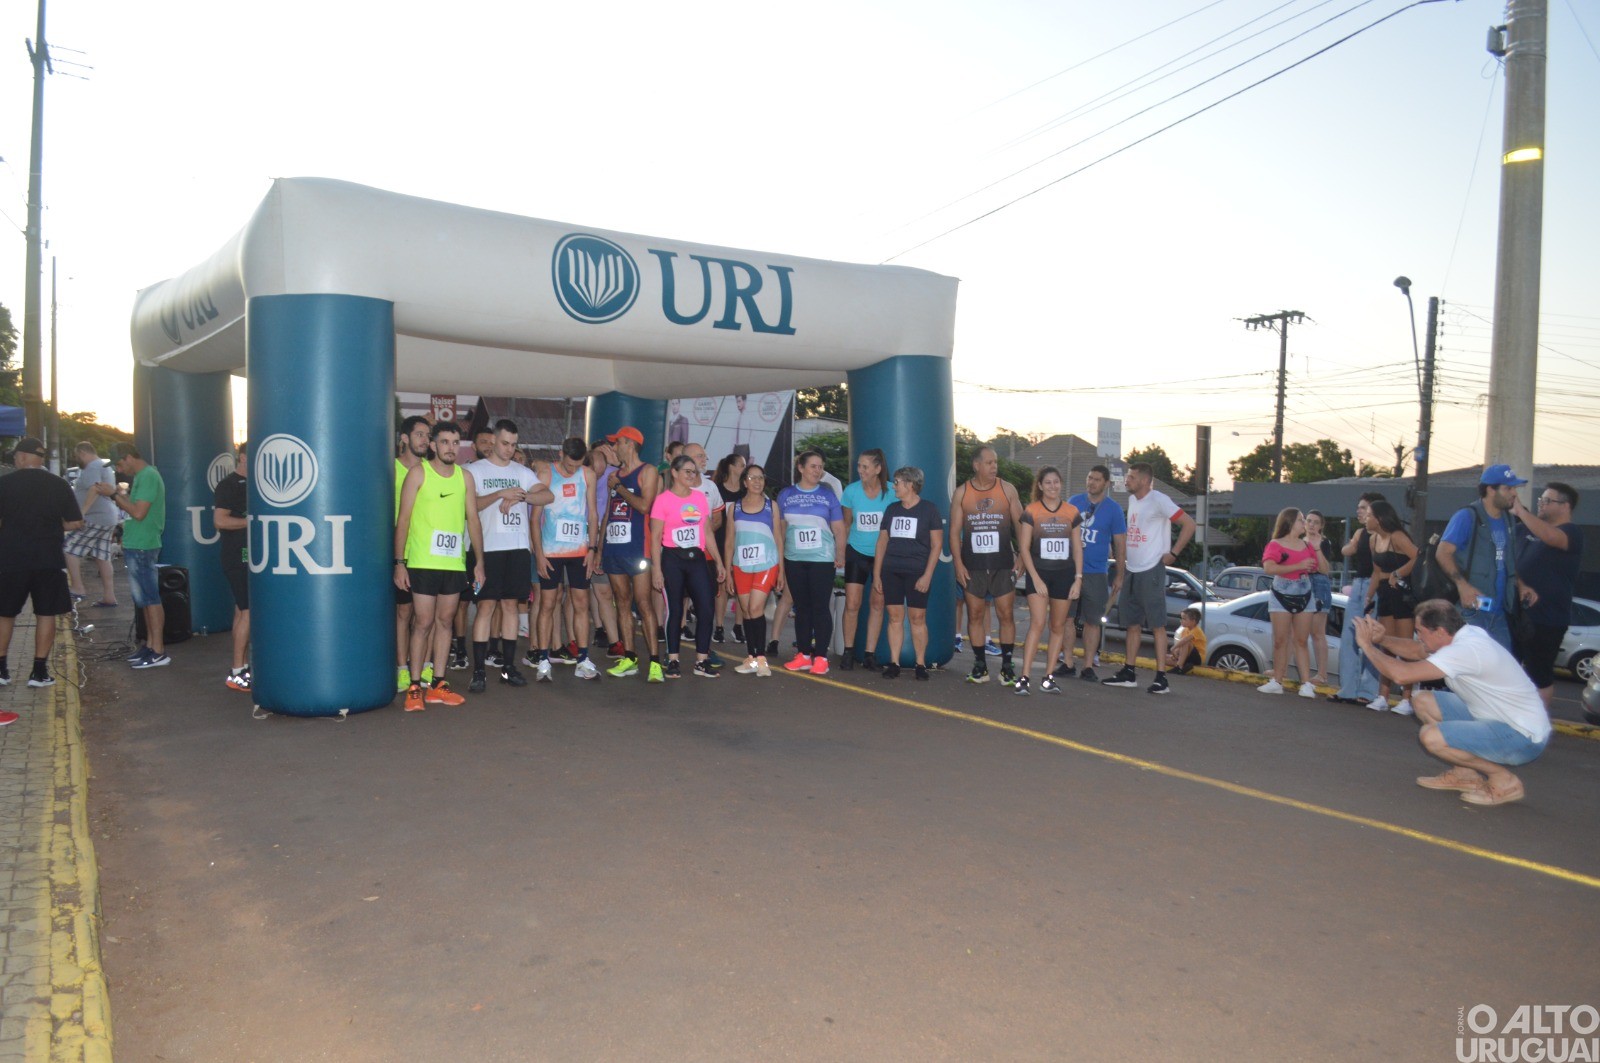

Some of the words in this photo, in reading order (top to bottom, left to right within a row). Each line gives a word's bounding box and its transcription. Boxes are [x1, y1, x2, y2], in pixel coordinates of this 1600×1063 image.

[646, 247, 798, 336] URI
[433, 407, 454, 422] 10
[502, 512, 521, 526] 025
[860, 513, 878, 525] 030
[982, 512, 1004, 520] Forma
[562, 522, 580, 536] 015
[609, 524, 627, 537] 003
[894, 518, 911, 531] 018
[436, 533, 457, 549] 030
[676, 528, 696, 542] 023
[799, 530, 817, 543] 012
[975, 534, 994, 547] 001
[1080, 527, 1099, 544] RI
[247, 514, 353, 575] URI
[1046, 540, 1065, 553] 001
[742, 546, 760, 559] 027
